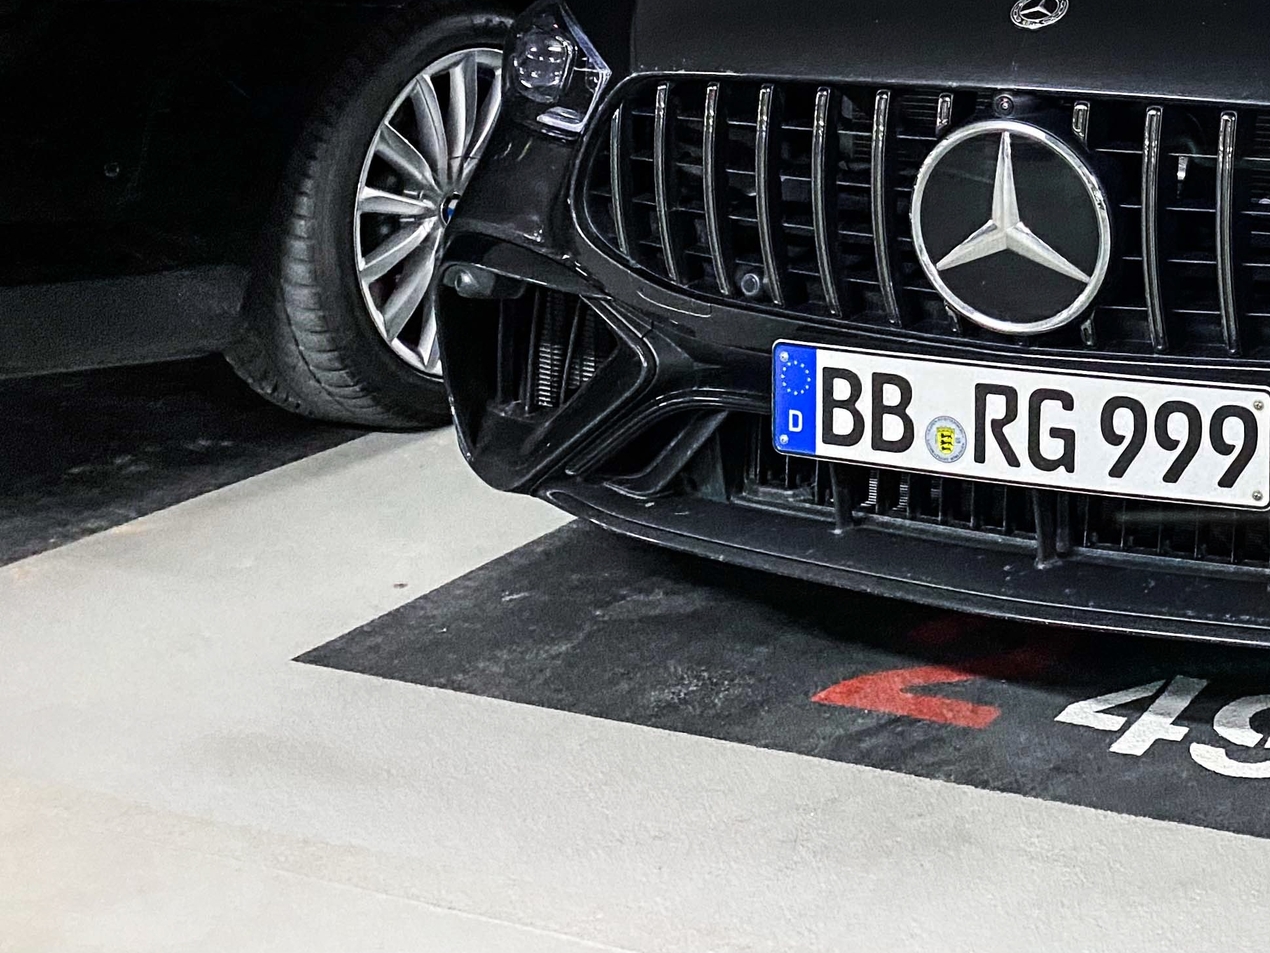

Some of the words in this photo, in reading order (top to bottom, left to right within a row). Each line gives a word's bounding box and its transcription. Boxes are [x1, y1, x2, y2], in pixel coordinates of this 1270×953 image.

[787, 409, 803, 433] D
[821, 366, 915, 453] BB
[973, 383, 1076, 474] RG
[1099, 395, 1260, 489] 999
